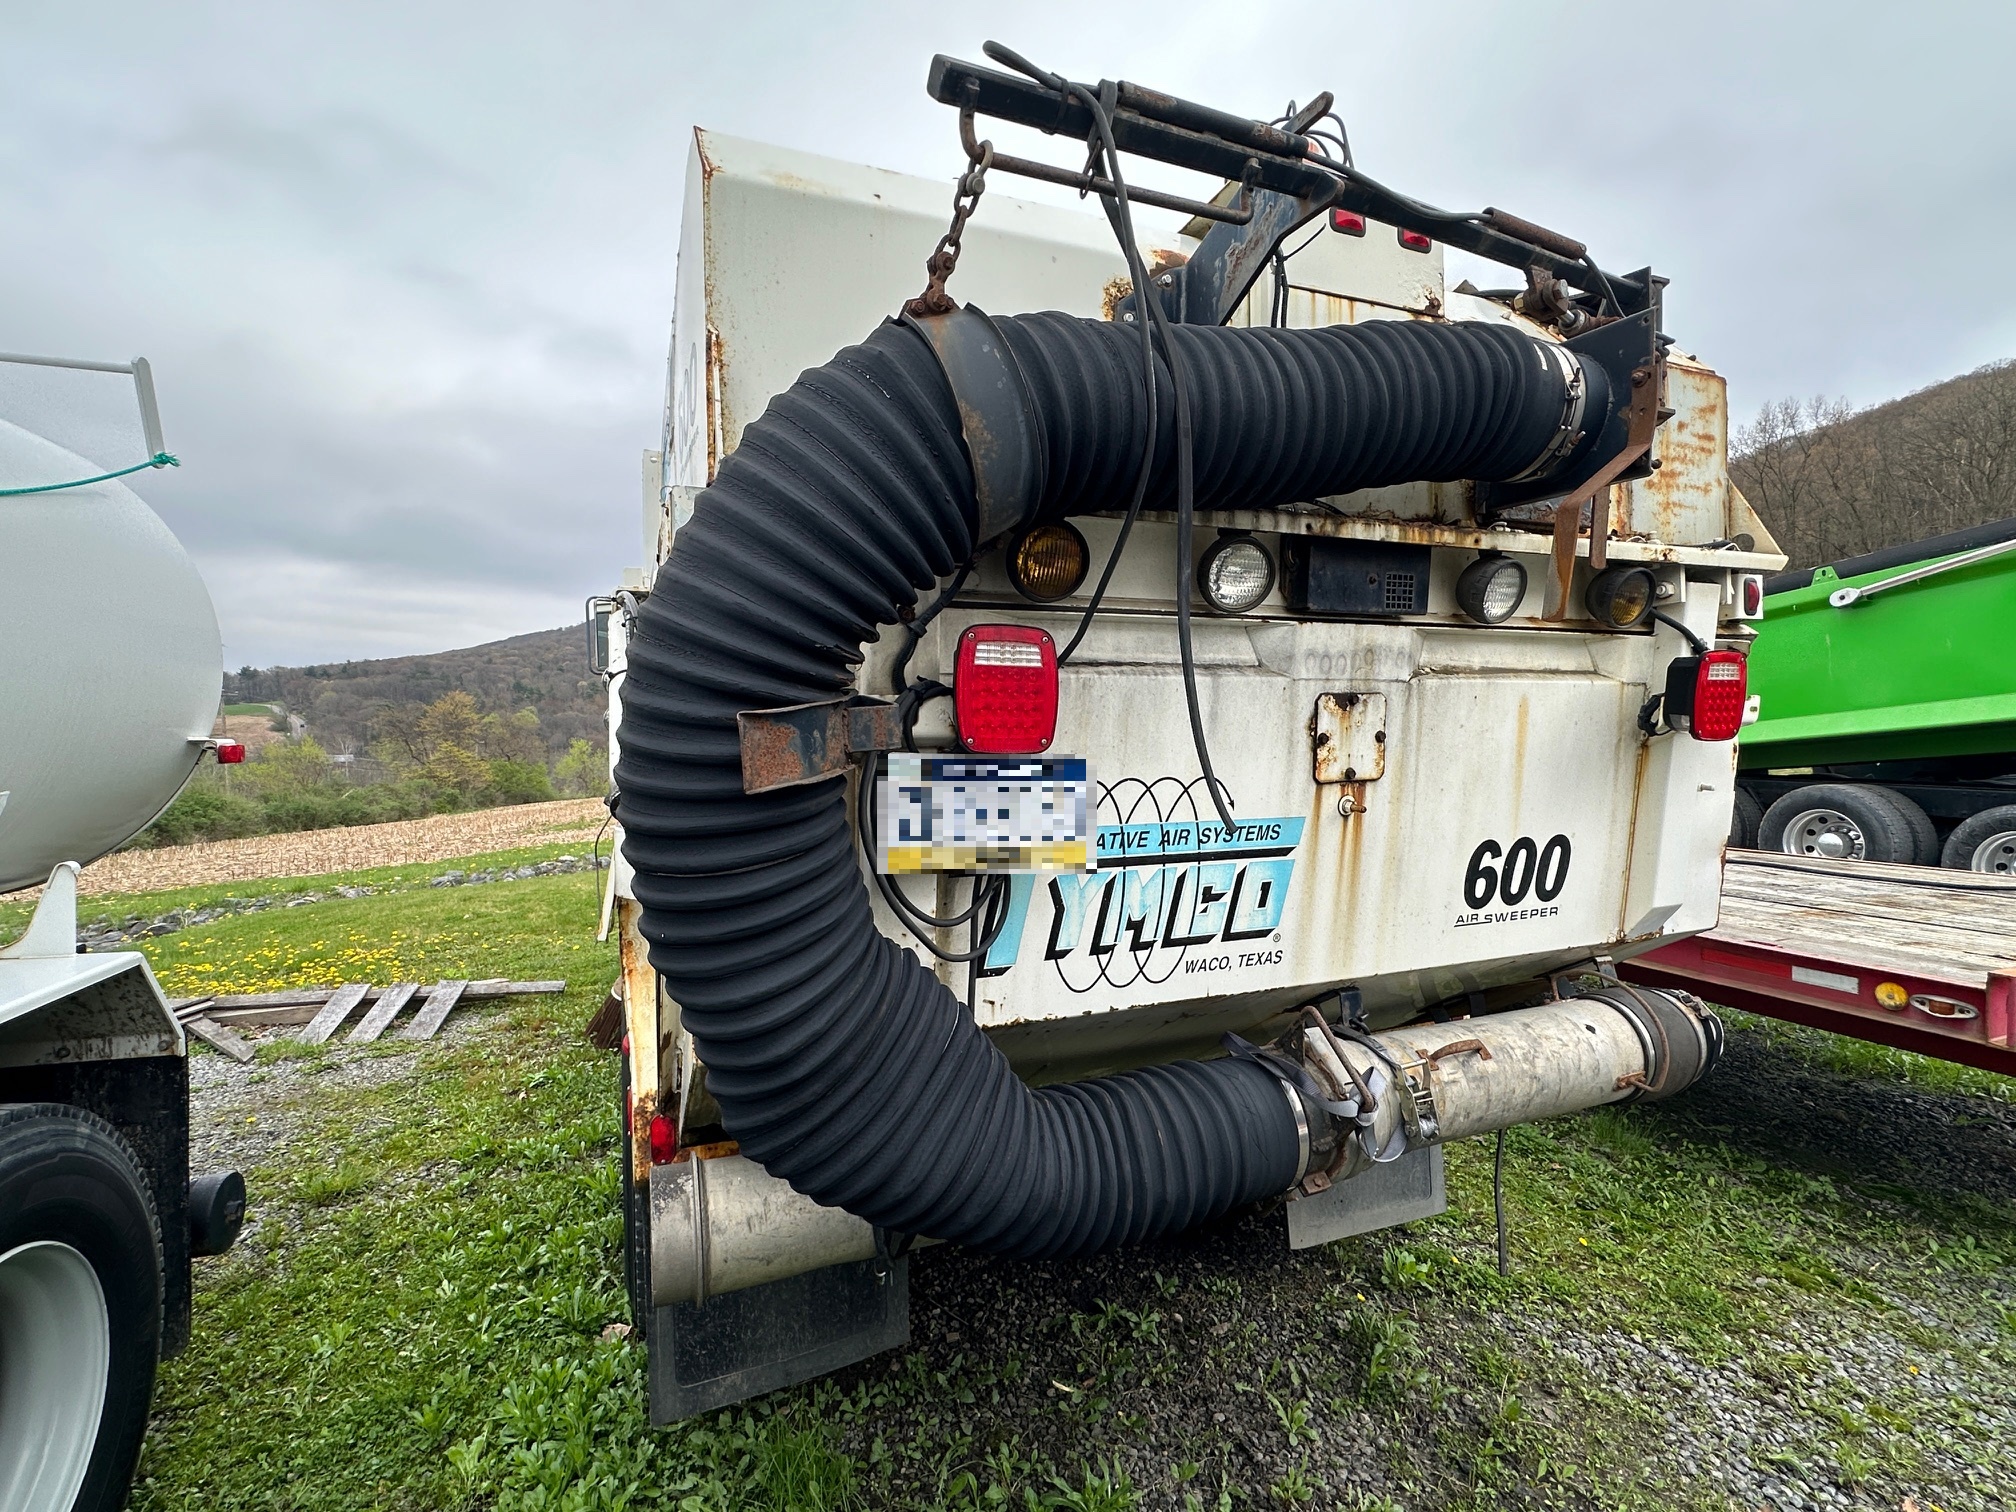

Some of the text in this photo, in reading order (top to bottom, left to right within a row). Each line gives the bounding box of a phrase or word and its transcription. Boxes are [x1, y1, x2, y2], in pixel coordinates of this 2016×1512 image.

[1097, 824, 1282, 850] ATIVE AIR SYSTEMS
[1464, 834, 1572, 910] 600
[977, 859, 1295, 978] TYMCO
[1456, 907, 1559, 925] AIR SWEEPER
[1185, 950, 1283, 974] WACO, TEXAS
